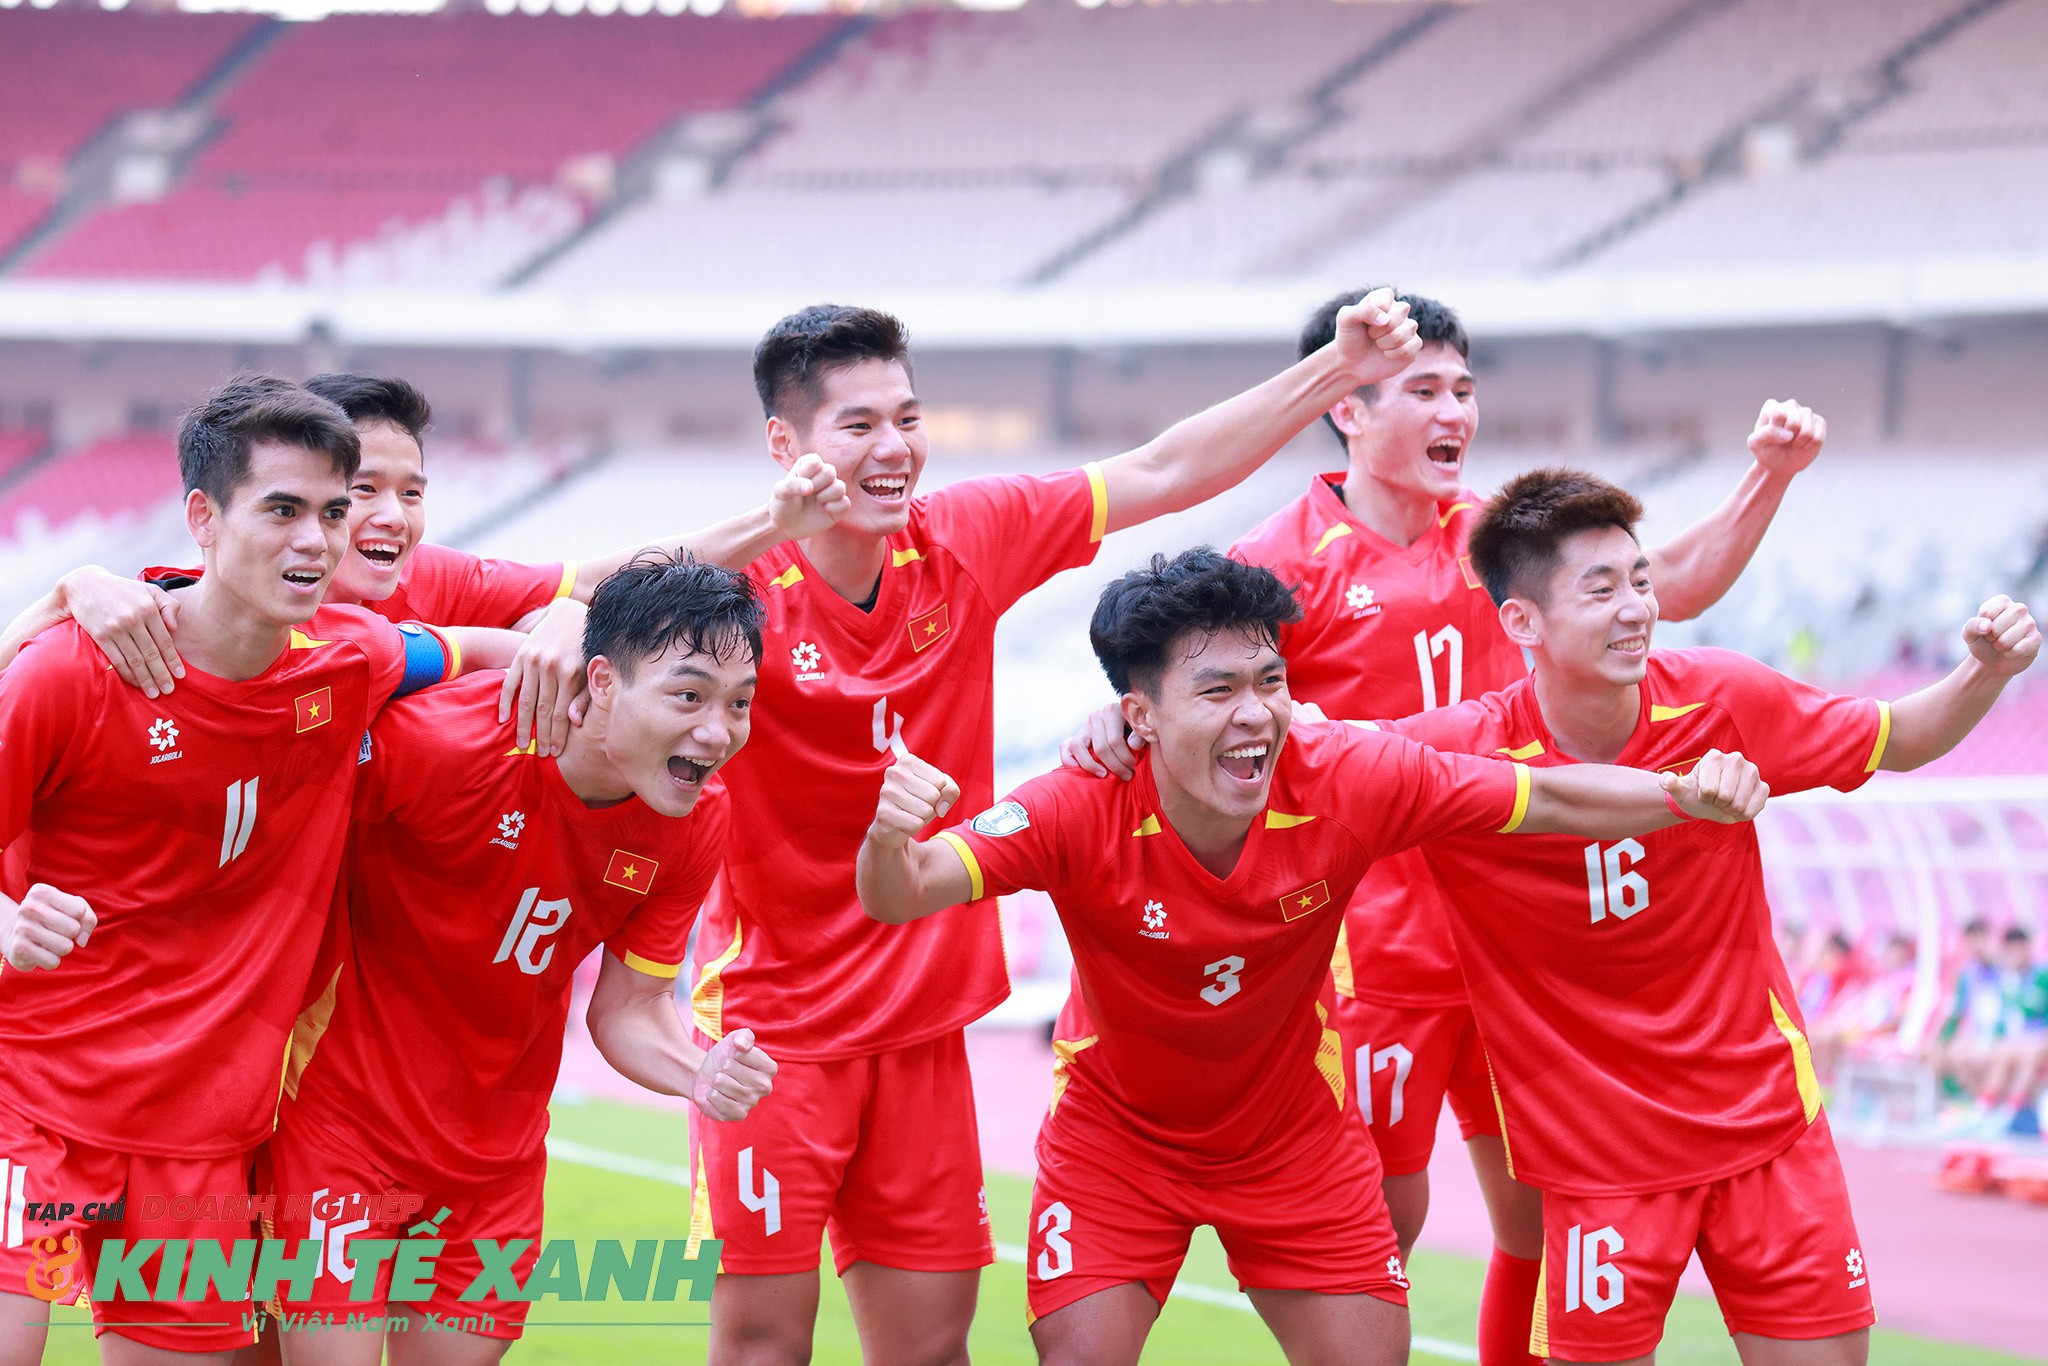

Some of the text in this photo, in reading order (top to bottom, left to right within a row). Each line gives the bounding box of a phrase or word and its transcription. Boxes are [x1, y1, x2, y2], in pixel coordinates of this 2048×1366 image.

[1413, 624, 1464, 711] 17
[218, 775, 260, 869] 11
[1583, 837, 1650, 924] 16
[492, 886, 573, 975] 12
[1200, 955, 1246, 1007] 3
[1355, 1042, 1414, 1128] 17
[737, 1145, 782, 1237] 4
[1037, 1201, 1073, 1281] 3
[1565, 1224, 1625, 1315] 16
